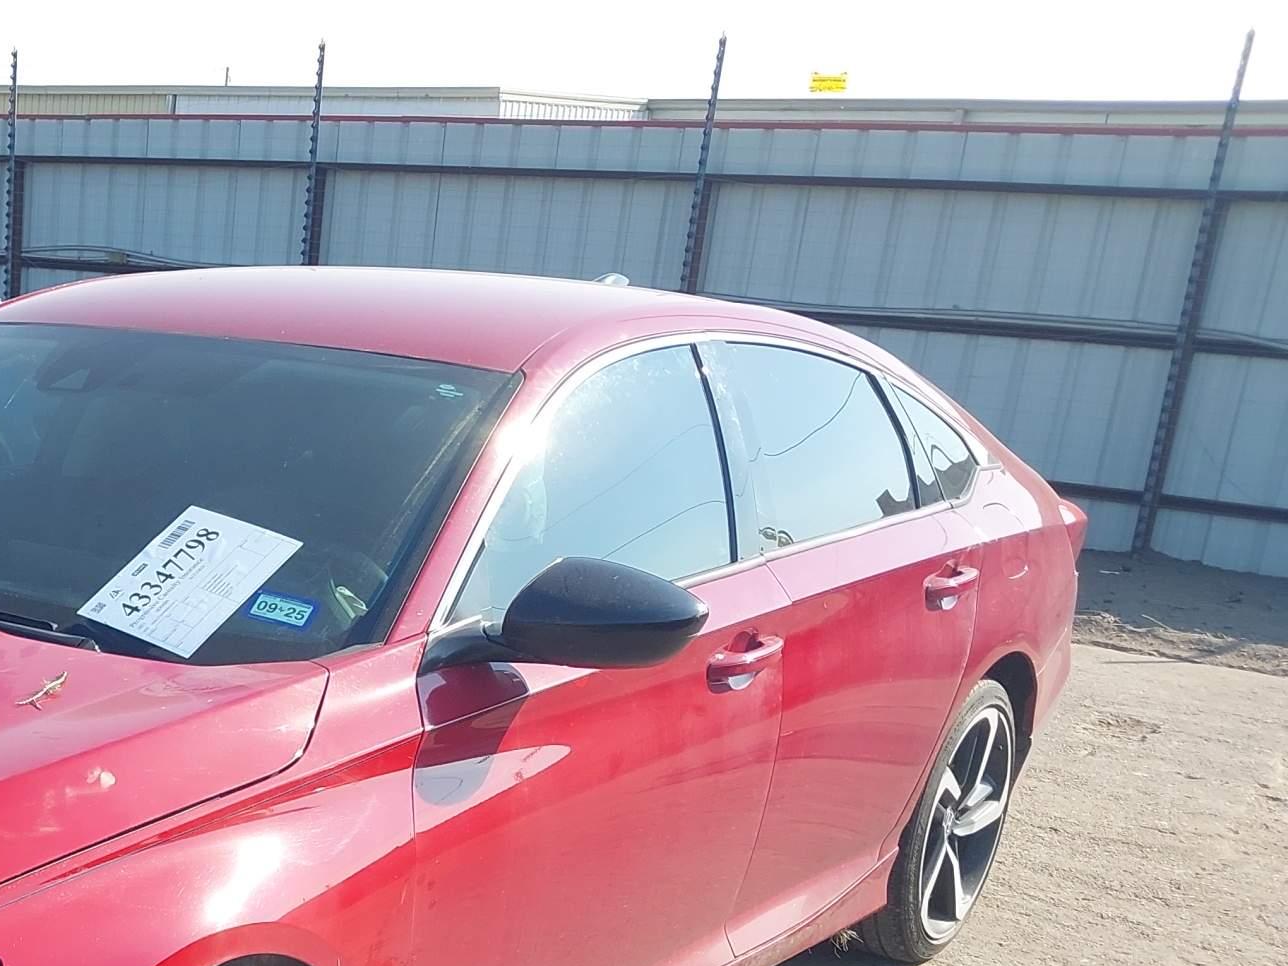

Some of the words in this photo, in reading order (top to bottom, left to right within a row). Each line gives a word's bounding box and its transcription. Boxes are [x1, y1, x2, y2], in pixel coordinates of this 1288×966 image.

[121, 527, 221, 618] 43347798
[256, 600, 278, 614] 09
[284, 607, 307, 621] 25
